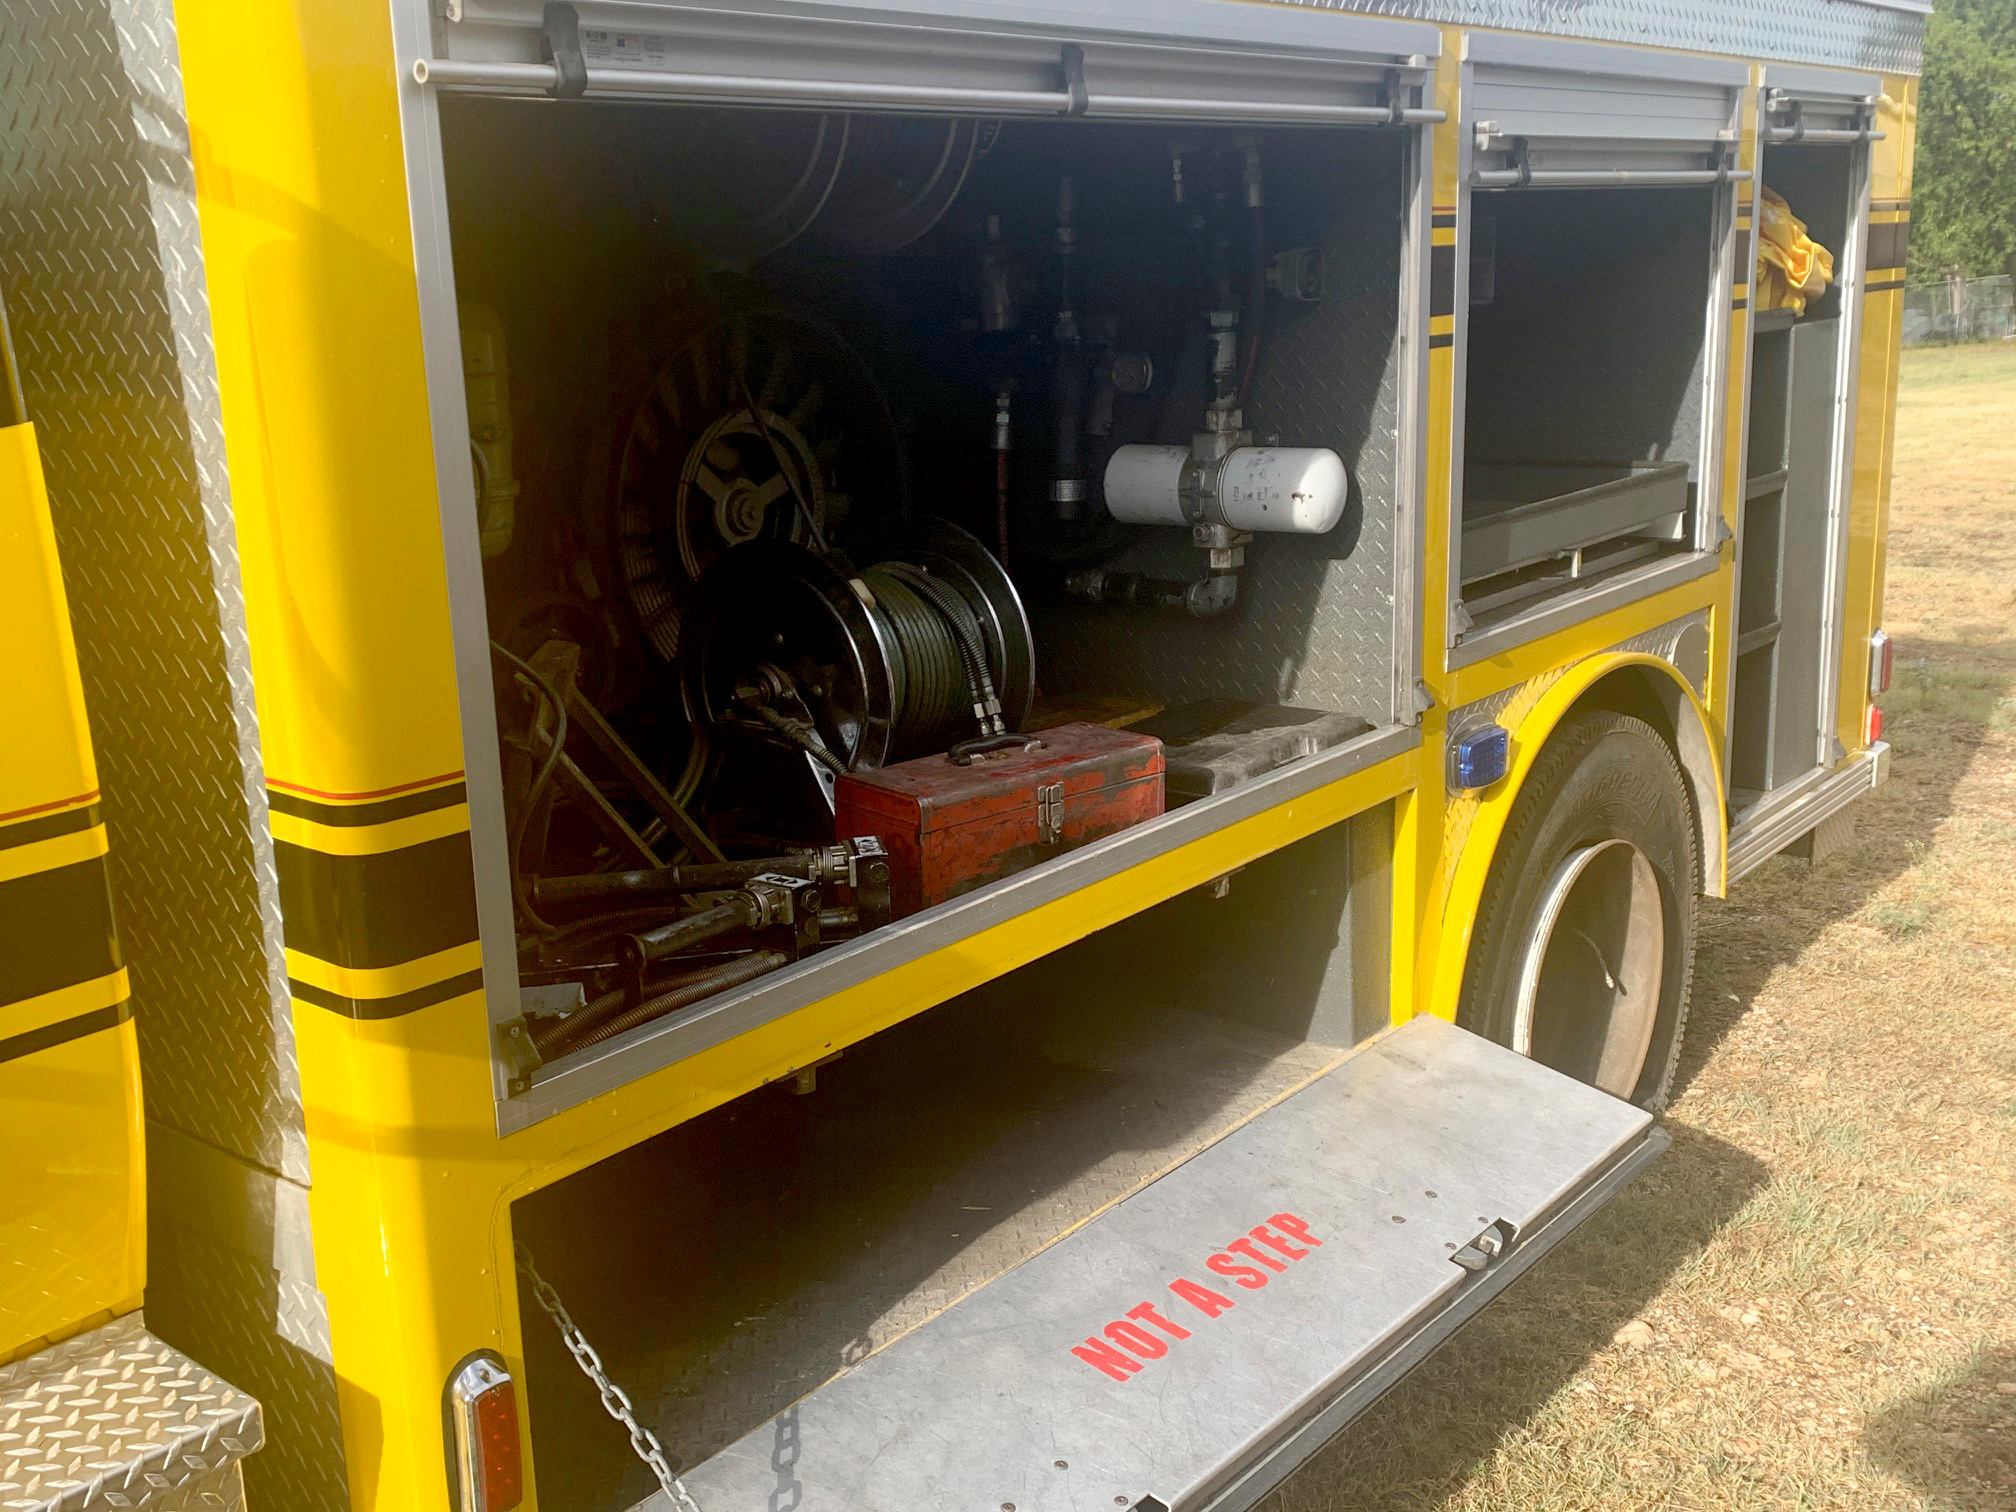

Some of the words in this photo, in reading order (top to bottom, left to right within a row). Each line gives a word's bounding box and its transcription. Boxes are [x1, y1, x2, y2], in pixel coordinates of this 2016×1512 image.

[1572, 768, 1657, 816] MICHELIN
[1070, 1301, 1192, 1382] NOT
[1168, 1278, 1235, 1319] A
[1206, 1213, 1323, 1290] STEP
